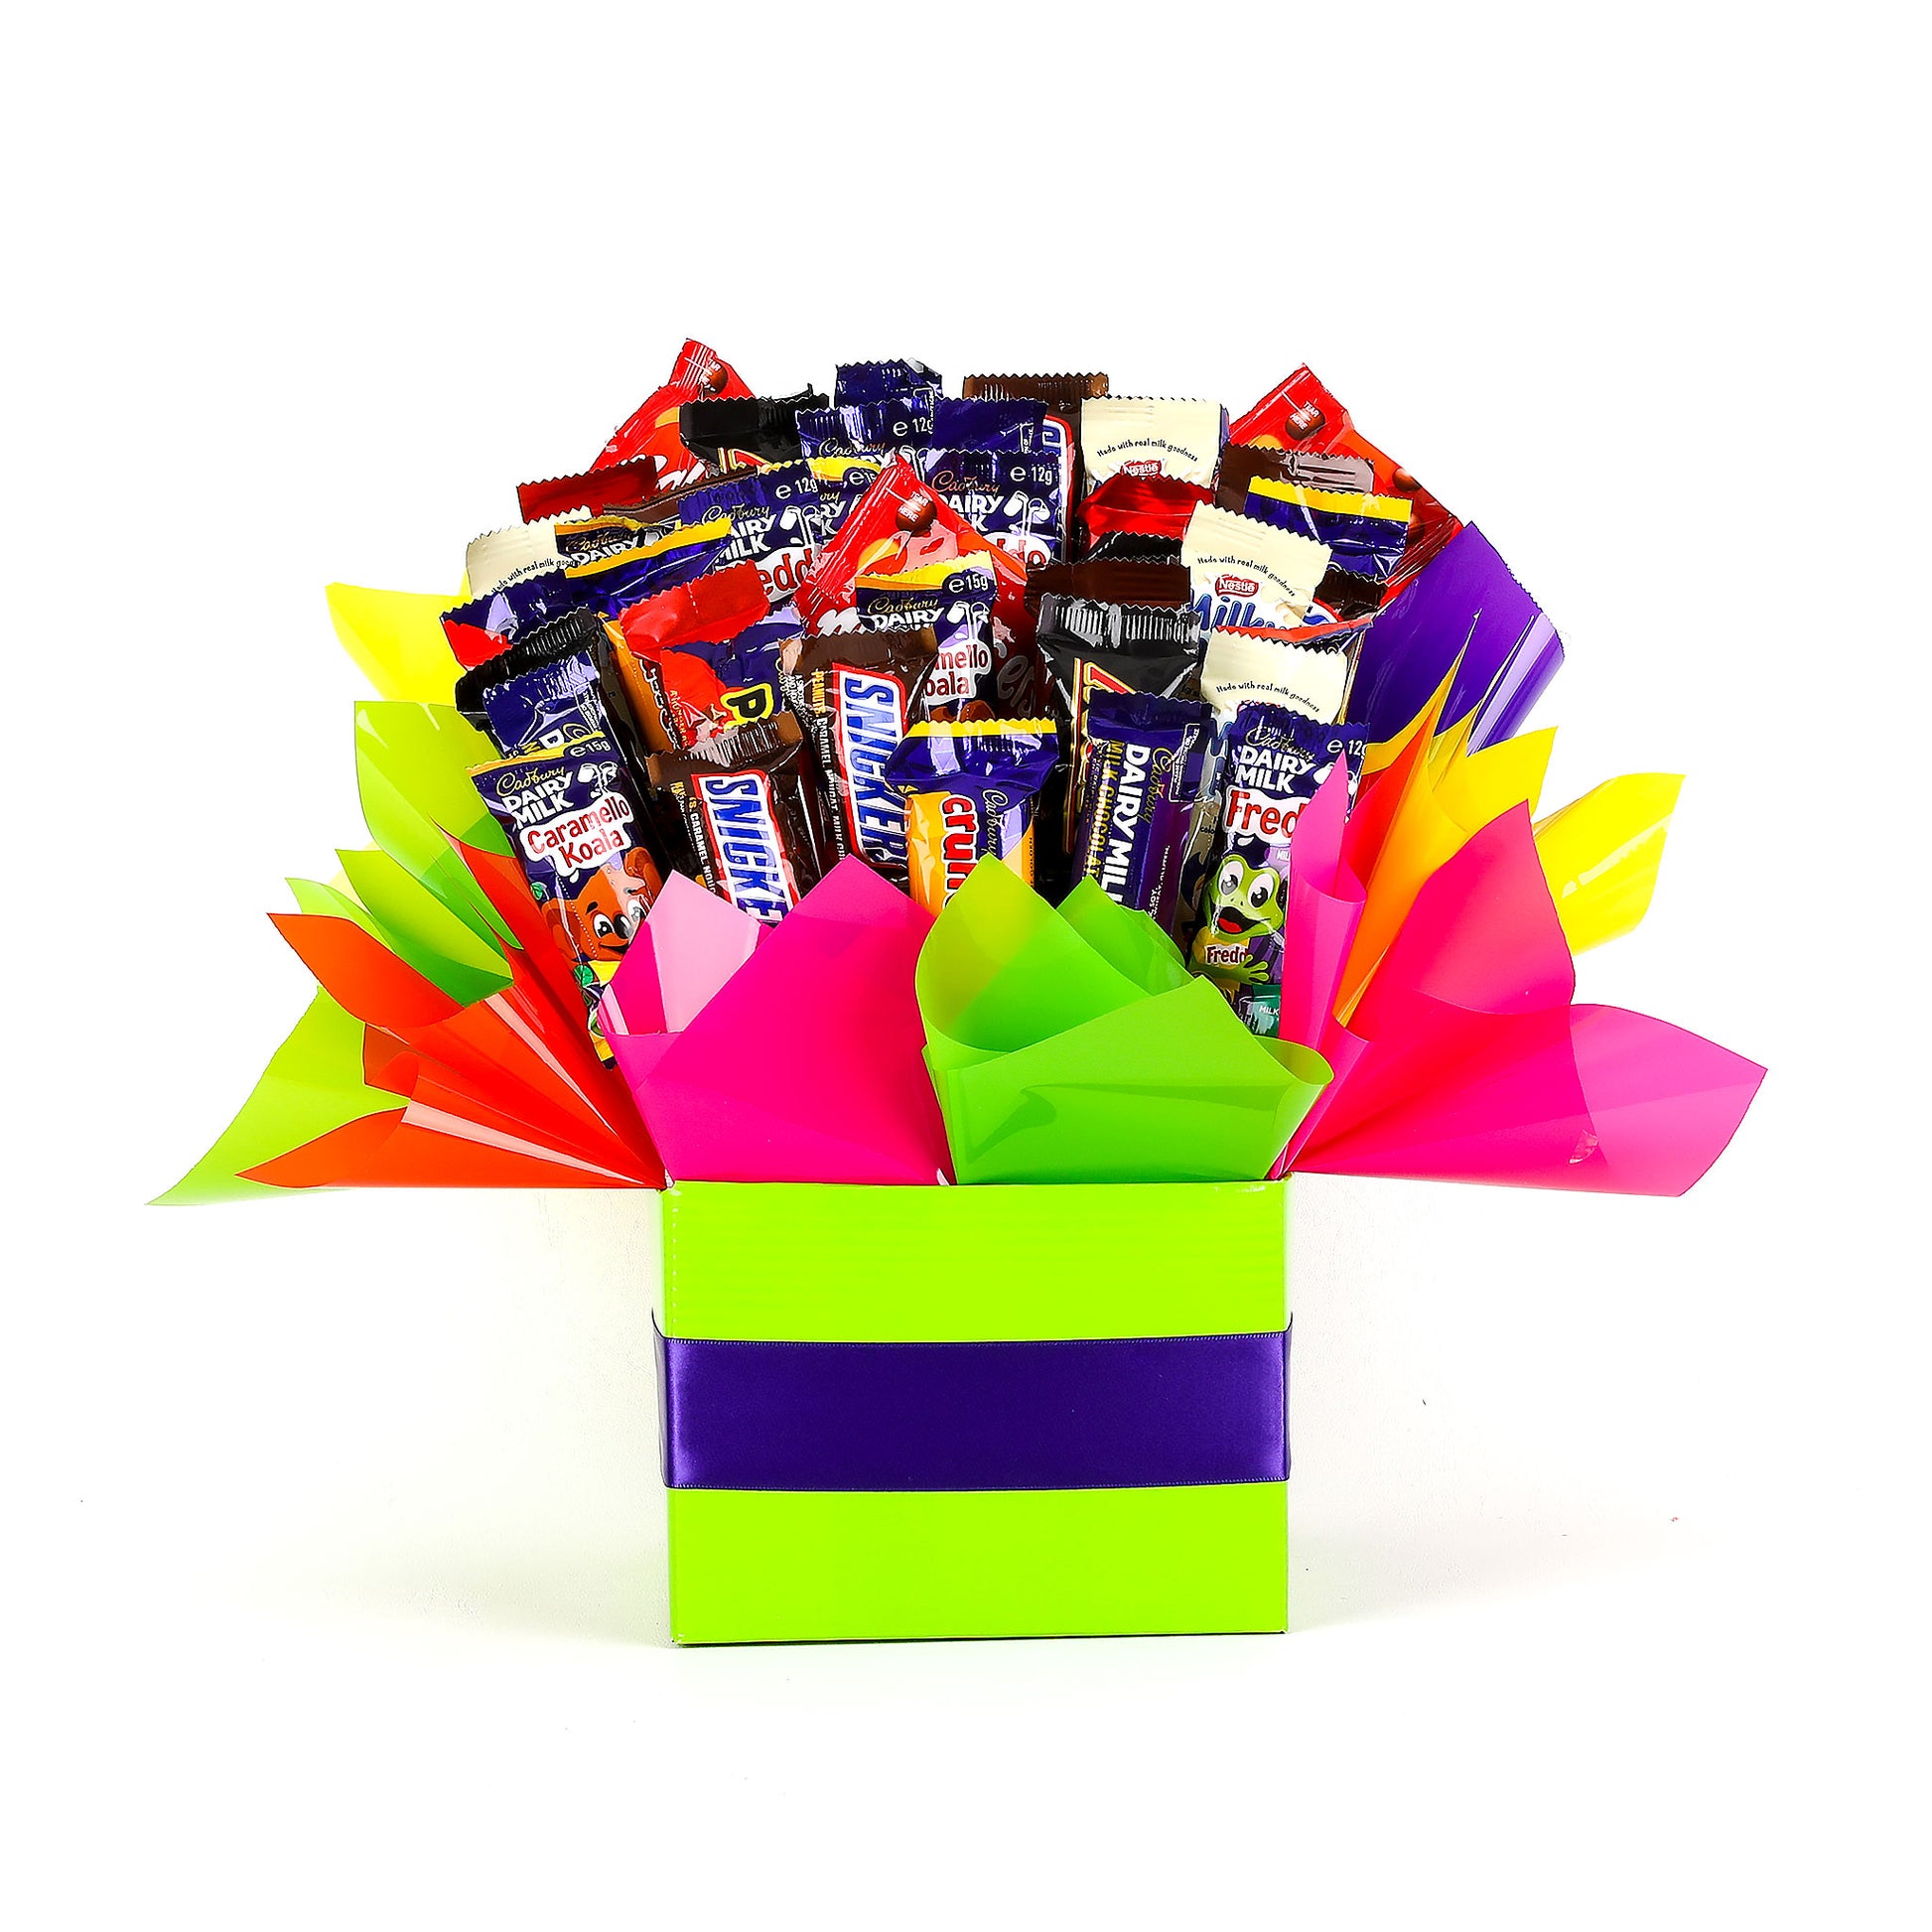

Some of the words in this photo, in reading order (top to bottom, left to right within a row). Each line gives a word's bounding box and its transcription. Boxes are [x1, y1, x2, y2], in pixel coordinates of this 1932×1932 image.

[1290, 412, 1309, 431] HERE
[1303, 399, 1321, 418] TEAR
[1117, 439, 1134, 451] with
[1134, 438, 1151, 448] real
[1151, 439, 1168, 449] milk
[1167, 444, 1198, 463] goodness
[795, 478, 818, 494] 12g
[932, 470, 1001, 496] Cadbury
[1031, 467, 1053, 485] 12g
[702, 503, 770, 524] Cadbury
[897, 504, 919, 523] HERE
[571, 536, 639, 566] DAIRY
[508, 567, 523, 582] with
[523, 560, 539, 574] real
[539, 558, 555, 568] milk
[1219, 555, 1236, 565] with
[1237, 559, 1253, 569] real
[1253, 563, 1269, 575] milk
[1268, 572, 1296, 598] goodness
[867, 597, 939, 616] Cadbury
[874, 607, 945, 630] DAIRY
[925, 673, 970, 696] oala
[1238, 680, 1256, 691] with
[1257, 683, 1273, 693] real
[1273, 685, 1290, 696] milk
[1289, 693, 1320, 714] goodness
[1101, 739, 1125, 782] MILK
[1239, 745, 1317, 775] DAIRY
[496, 766, 565, 797] Cadbury
[501, 770, 574, 812] DAIRY
[1113, 743, 1152, 841] DAIRY
[1139, 747, 1175, 823] Cadbury
[1235, 764, 1296, 794] MILK
[510, 790, 575, 830] MILK
[527, 795, 630, 855] Caramello
[558, 827, 624, 869] Koala
[1082, 784, 1116, 882] CHOCOLAT
[705, 778, 790, 924] SNICKE
[1276, 851, 1291, 861] MIL
